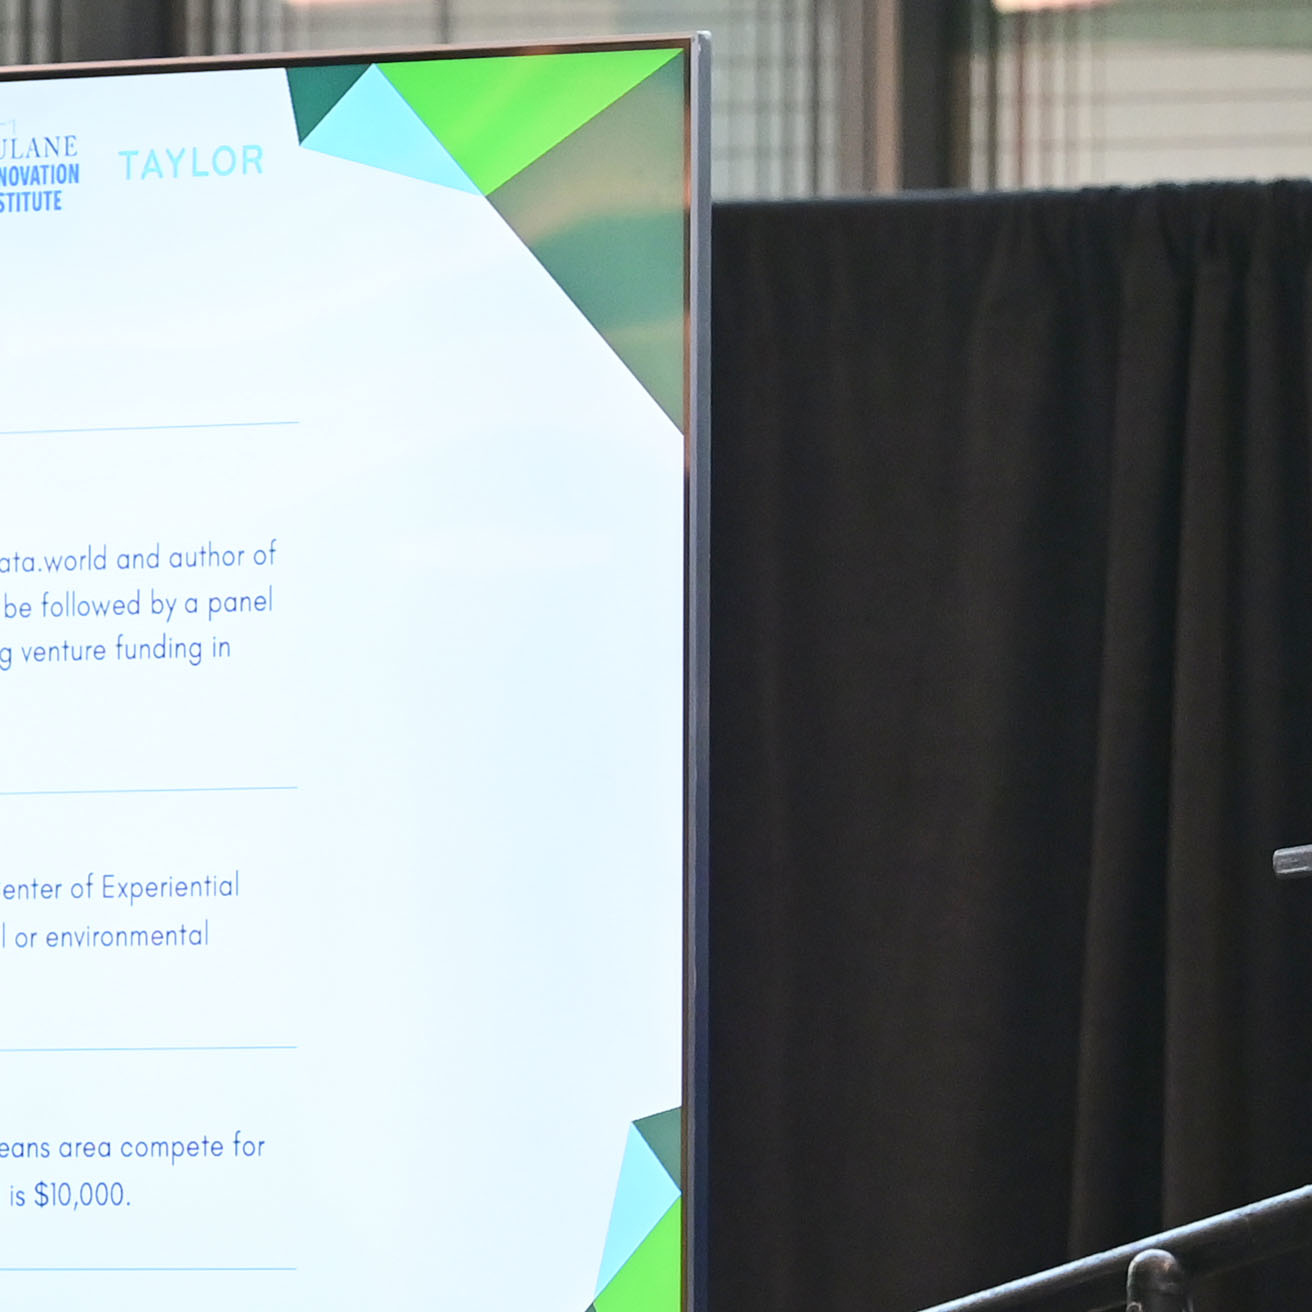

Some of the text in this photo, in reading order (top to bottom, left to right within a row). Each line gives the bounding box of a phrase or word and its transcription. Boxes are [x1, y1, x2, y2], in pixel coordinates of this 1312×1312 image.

[118, 144, 263, 181] TAYLOR
[4, 592, 32, 619] be
[41, 588, 140, 618] followed
[151, 588, 177, 624] by
[185, 597, 198, 614] a
[208, 585, 272, 622] panel
[71, 871, 94, 900] of
[103, 870, 239, 907] Experiential
[59, 1141, 111, 1158] area
[120, 1135, 223, 1166] compete
[233, 1130, 265, 1158] for
[10, 1185, 26, 1207] is
[34, 1180, 131, 1211] $10,000.
